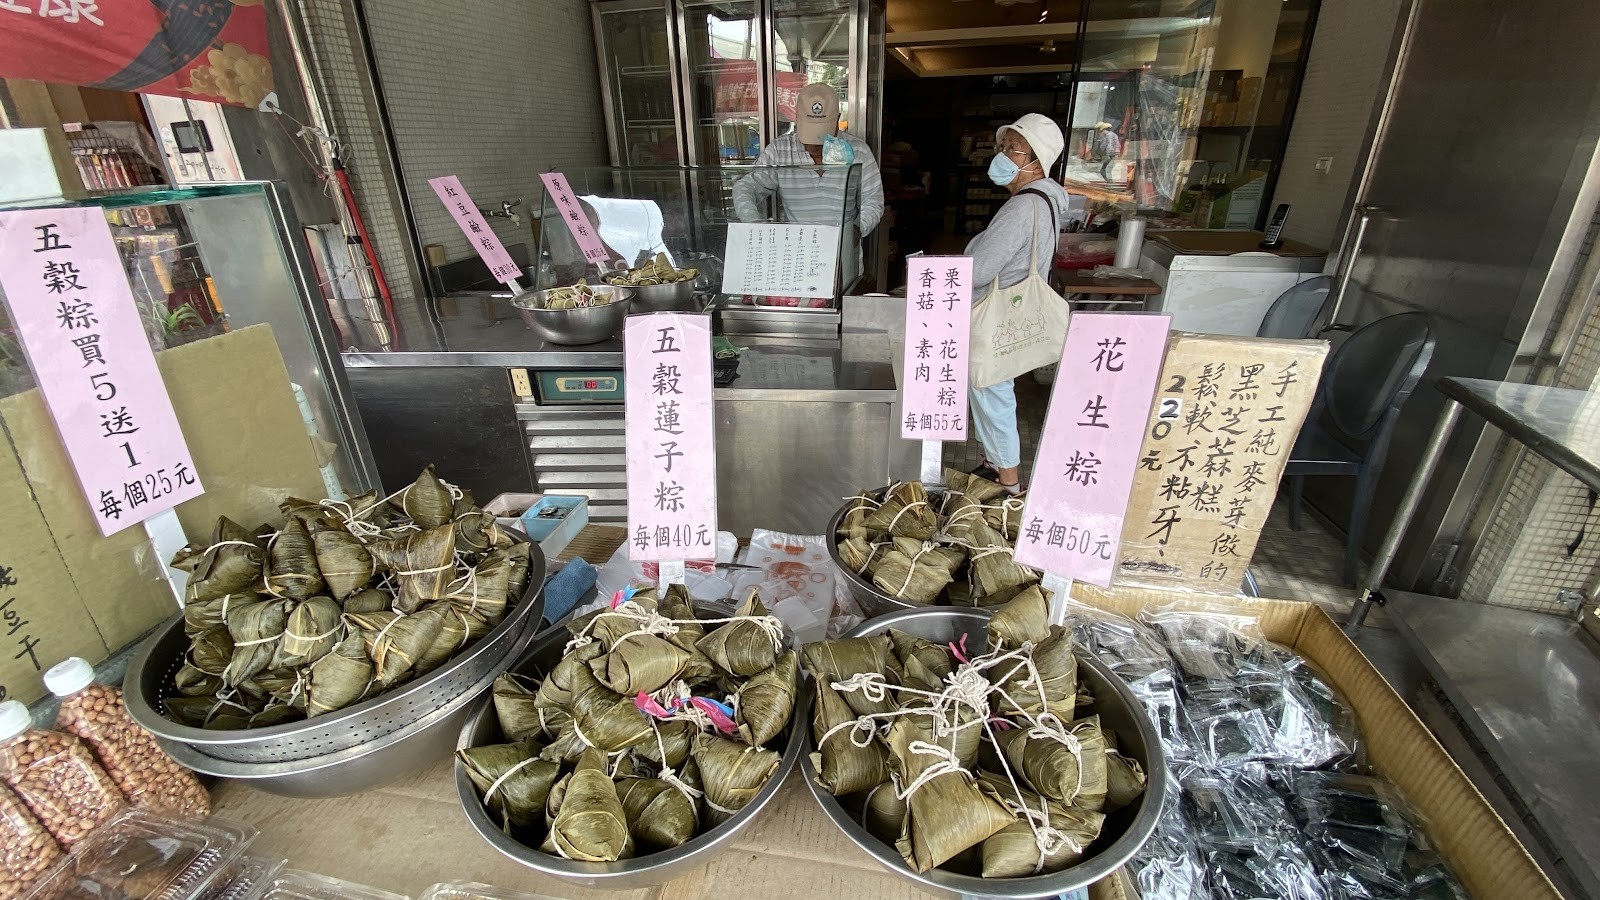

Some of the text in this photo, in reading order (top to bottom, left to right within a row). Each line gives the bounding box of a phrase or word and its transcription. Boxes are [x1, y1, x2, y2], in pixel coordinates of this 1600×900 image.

[33, 223, 142, 469] 五穀粽買5送1
[915, 267, 937, 382] 香菇、素肉
[936, 267, 962, 407] 栗子、花生粽
[651, 326, 685, 513] 五穀蓮子粽
[904, 412, 963, 432] 每個55元
[1063, 336, 1127, 488] 花生粽
[1139, 374, 1187, 471] 220元
[99, 462, 196, 520] 每個25元
[1200, 360, 1298, 582] 手工純麥芽做的
[633, 523, 711, 551] 每個40元
[1024, 516, 1112, 561] 每個50元
